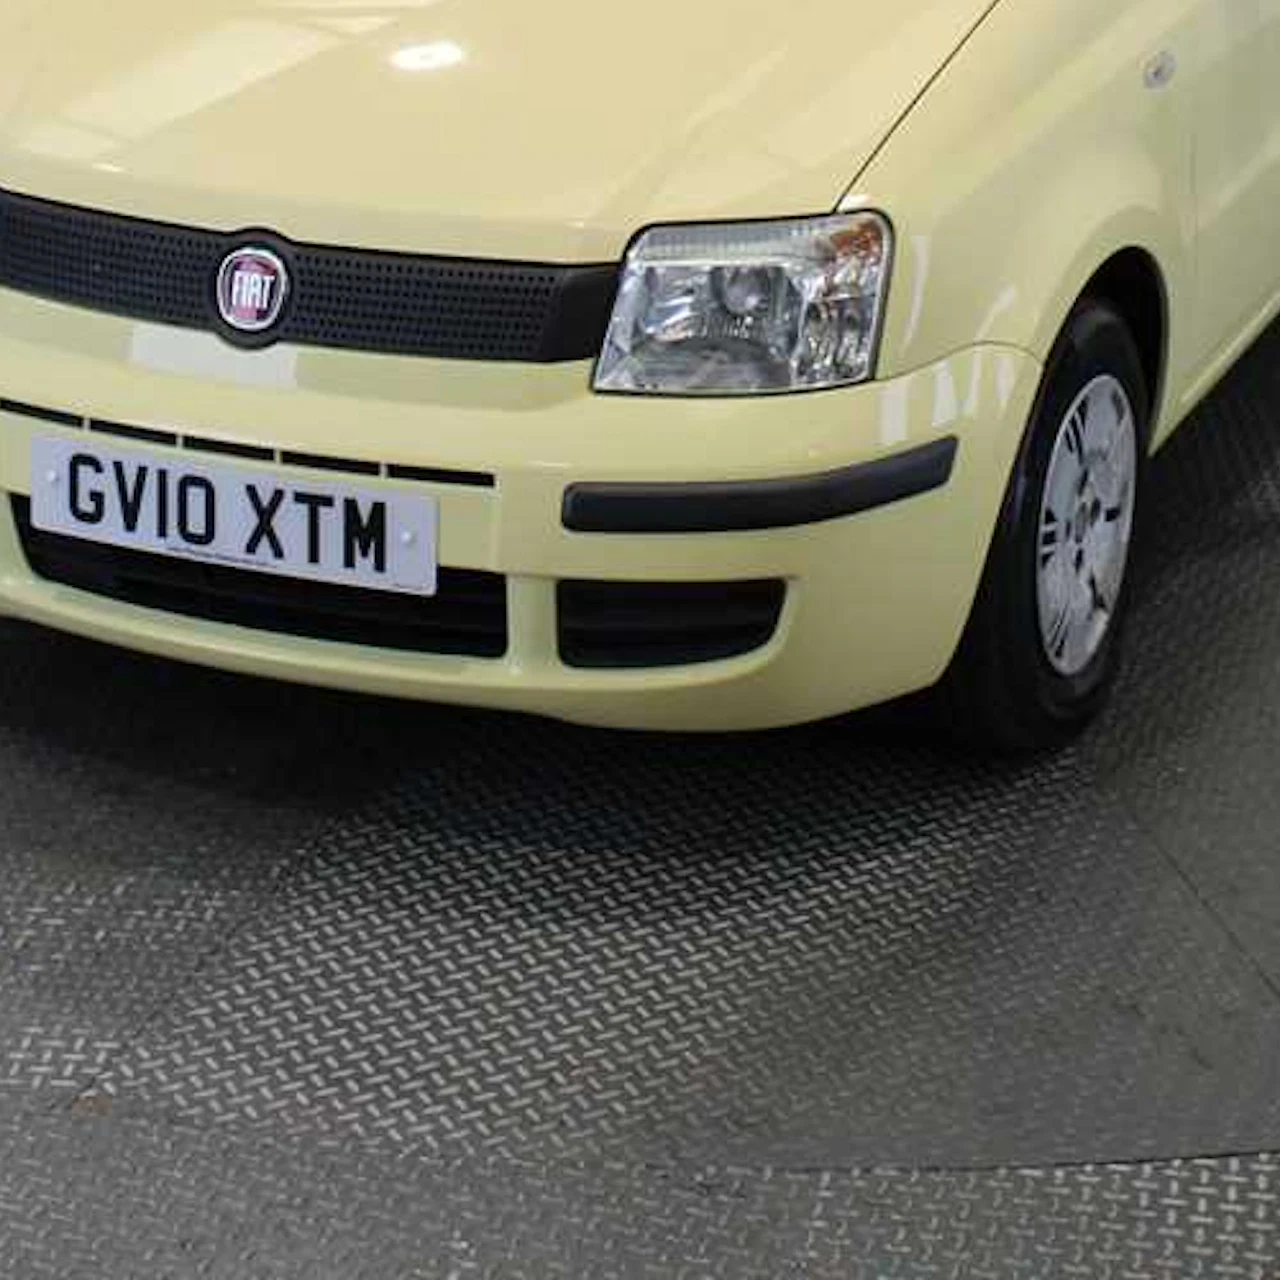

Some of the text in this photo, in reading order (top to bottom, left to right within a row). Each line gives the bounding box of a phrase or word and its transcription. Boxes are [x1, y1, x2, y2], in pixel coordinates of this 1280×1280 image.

[232, 270, 275, 309] FIAT
[68, 453, 387, 573] GV10 XTM
